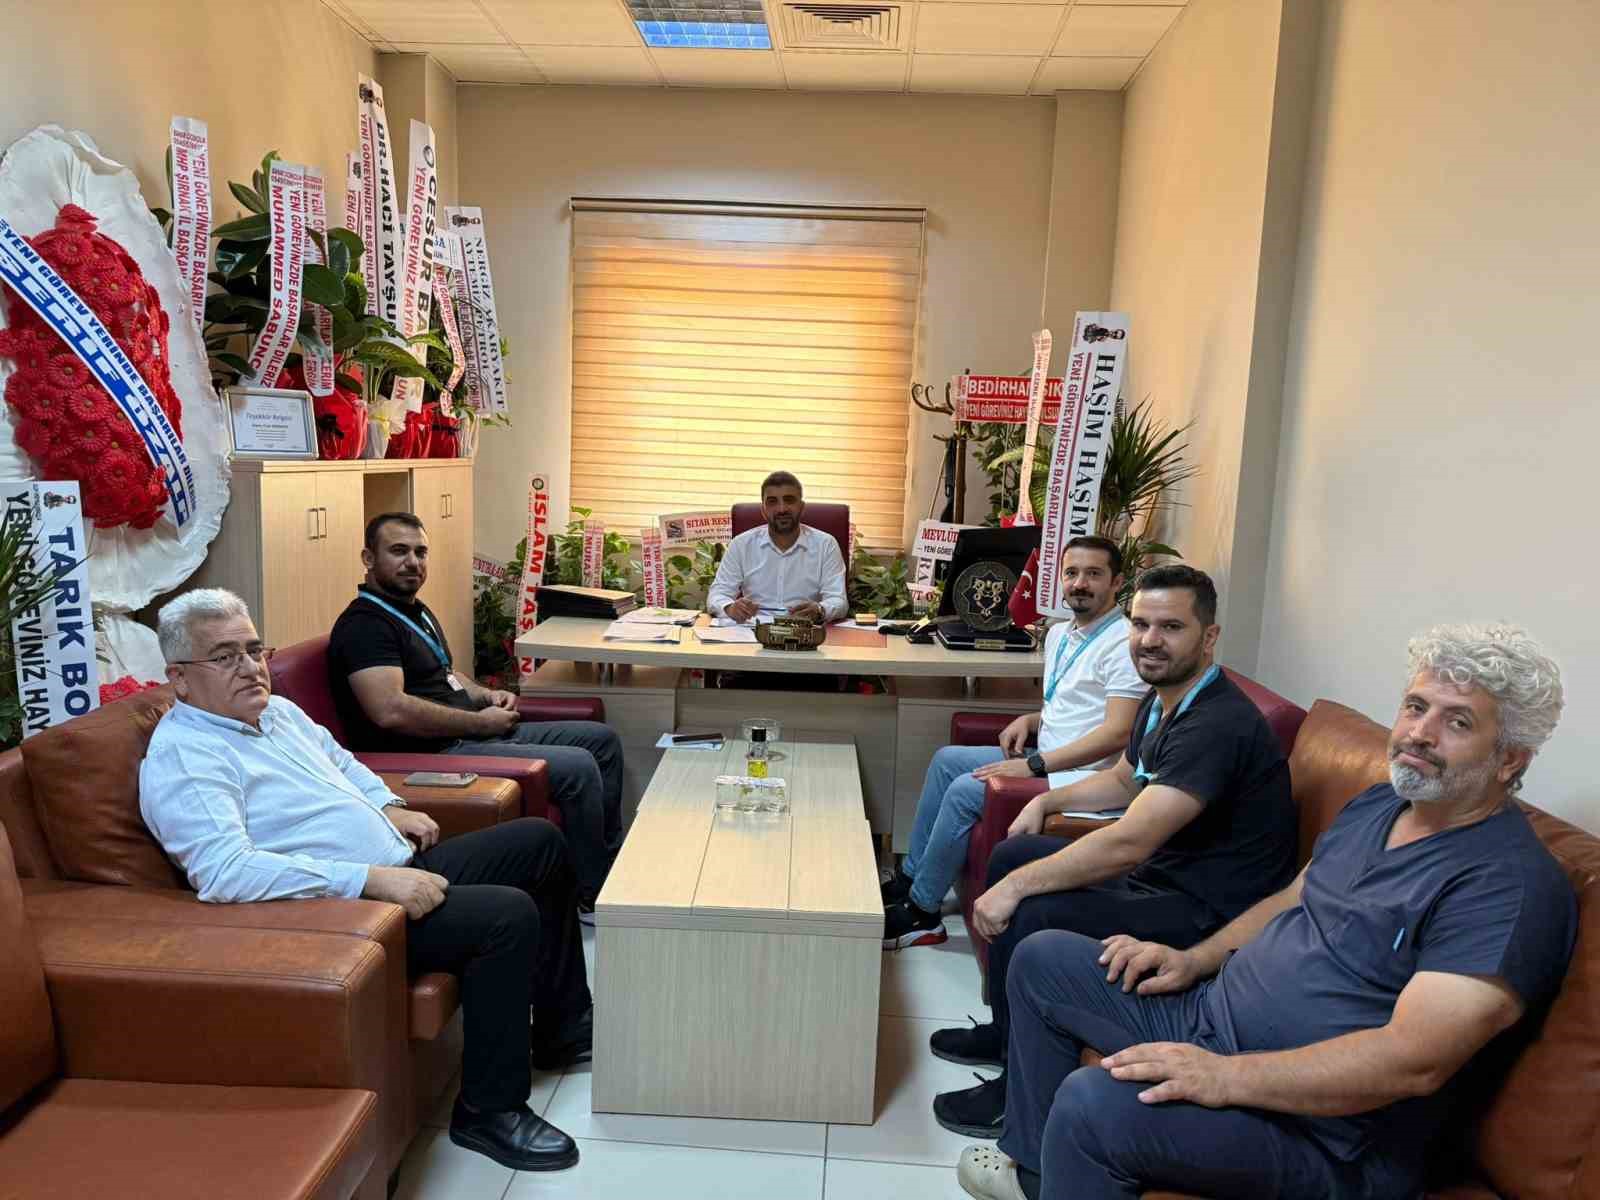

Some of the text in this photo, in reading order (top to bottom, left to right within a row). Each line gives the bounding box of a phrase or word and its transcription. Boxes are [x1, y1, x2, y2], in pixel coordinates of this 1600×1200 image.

[175, 147, 189, 173] MHP
[360, 113, 369, 140] YENİ
[175, 173, 192, 214] ŞIRNAK
[193, 153, 208, 180] YENİ
[290, 189, 302, 214] YENİ
[362, 143, 373, 221] GÖREVİNİZDE
[413, 166, 427, 200] YENİ
[194, 181, 211, 258] GÖREVİNİZDE
[272, 185, 286, 291] MUHAMMED
[289, 214, 304, 287] GÖREVİNİZDE
[406, 203, 423, 285] GÖREVİNİZ
[420, 175, 437, 282] CESUR
[2, 228, 41, 264] YENİ
[37, 264, 89, 317] GÖREV
[87, 317, 139, 384] YERİNDE
[137, 384, 188, 466] BAŞARILAR
[277, 288, 298, 349] BAŞARILAR
[260, 349, 286, 388] DİLERİZ
[1070, 352, 1085, 381] YENİ
[1084, 353, 1116, 440] HAŞİM
[1056, 383, 1079, 466] GÖREVİNİZDE
[529, 493, 549, 573] İSLAM
[1046, 468, 1063, 538] BAŞARILAR
[48, 527, 85, 650] TARIK
[1039, 541, 1056, 608] DİLİYORUM
